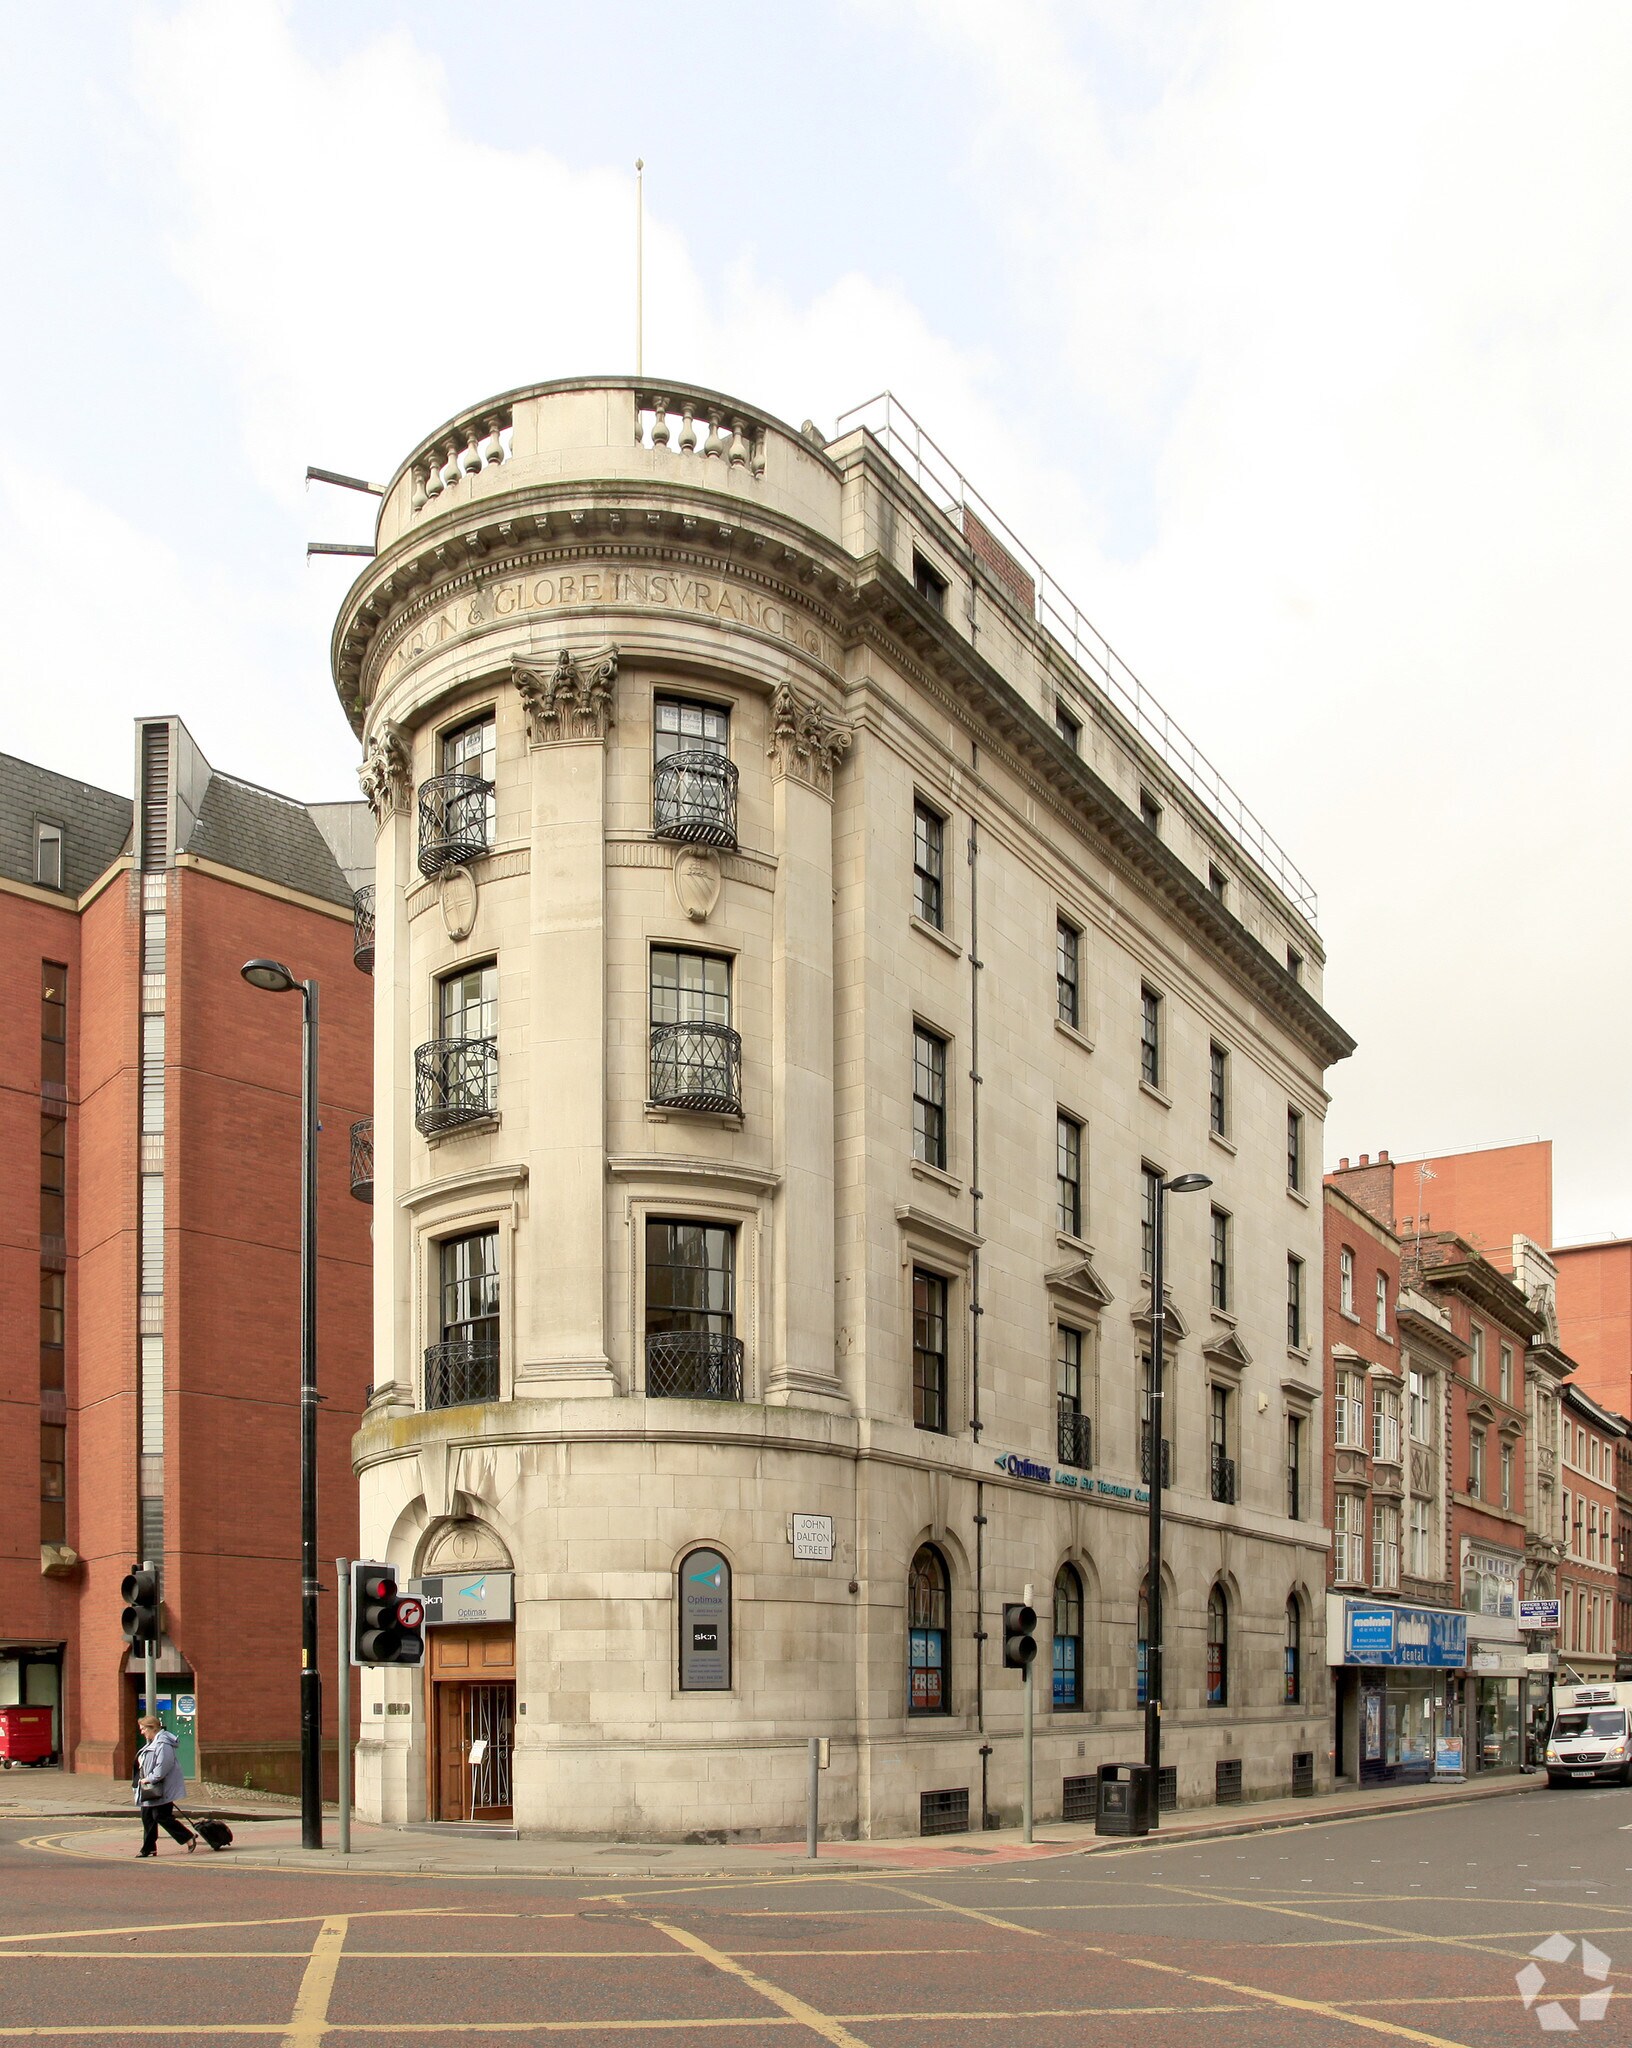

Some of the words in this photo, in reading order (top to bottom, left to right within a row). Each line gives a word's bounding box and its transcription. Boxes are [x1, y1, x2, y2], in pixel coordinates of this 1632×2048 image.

[467, 600, 485, 625] &
[494, 573, 603, 616] GLOBE
[1007, 1454, 1051, 1482] Optimax
[801, 1519, 825, 1529] JOHN
[796, 1531, 830, 1542] DALTON
[797, 1544, 829, 1555] STREET
[687, 1595, 723, 1605] Optimax
[457, 1608, 487, 1618] Optimax
[1402, 1647, 1424, 1661] dental
[914, 1673, 938, 1690] FREE
